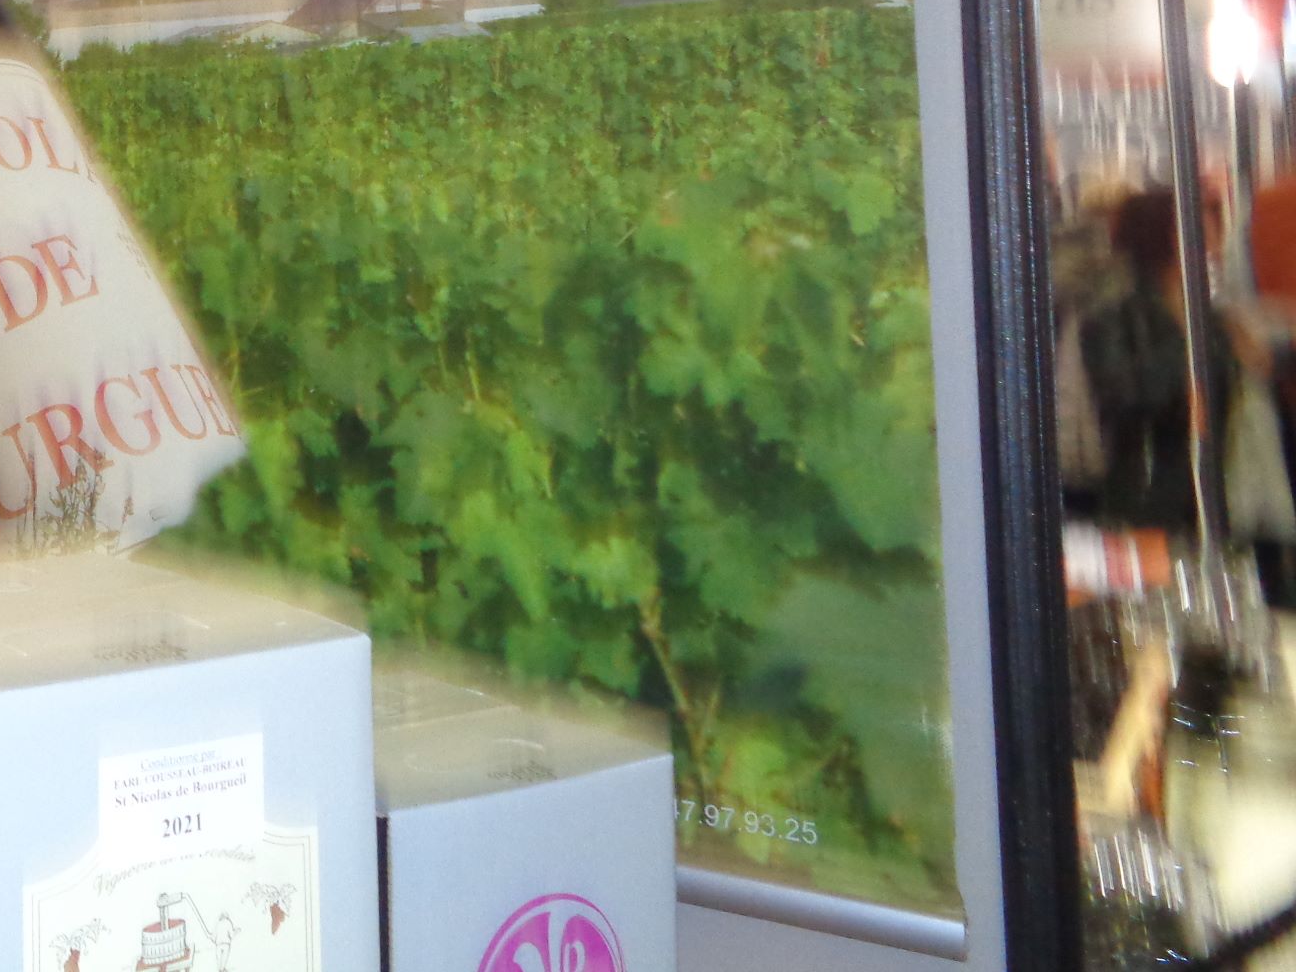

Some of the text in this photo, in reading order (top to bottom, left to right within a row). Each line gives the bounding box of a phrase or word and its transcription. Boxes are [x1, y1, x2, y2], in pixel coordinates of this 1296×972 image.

[114, 772, 247, 809] St Nicolas de Bourgueil
[162, 812, 203, 838] 2021
